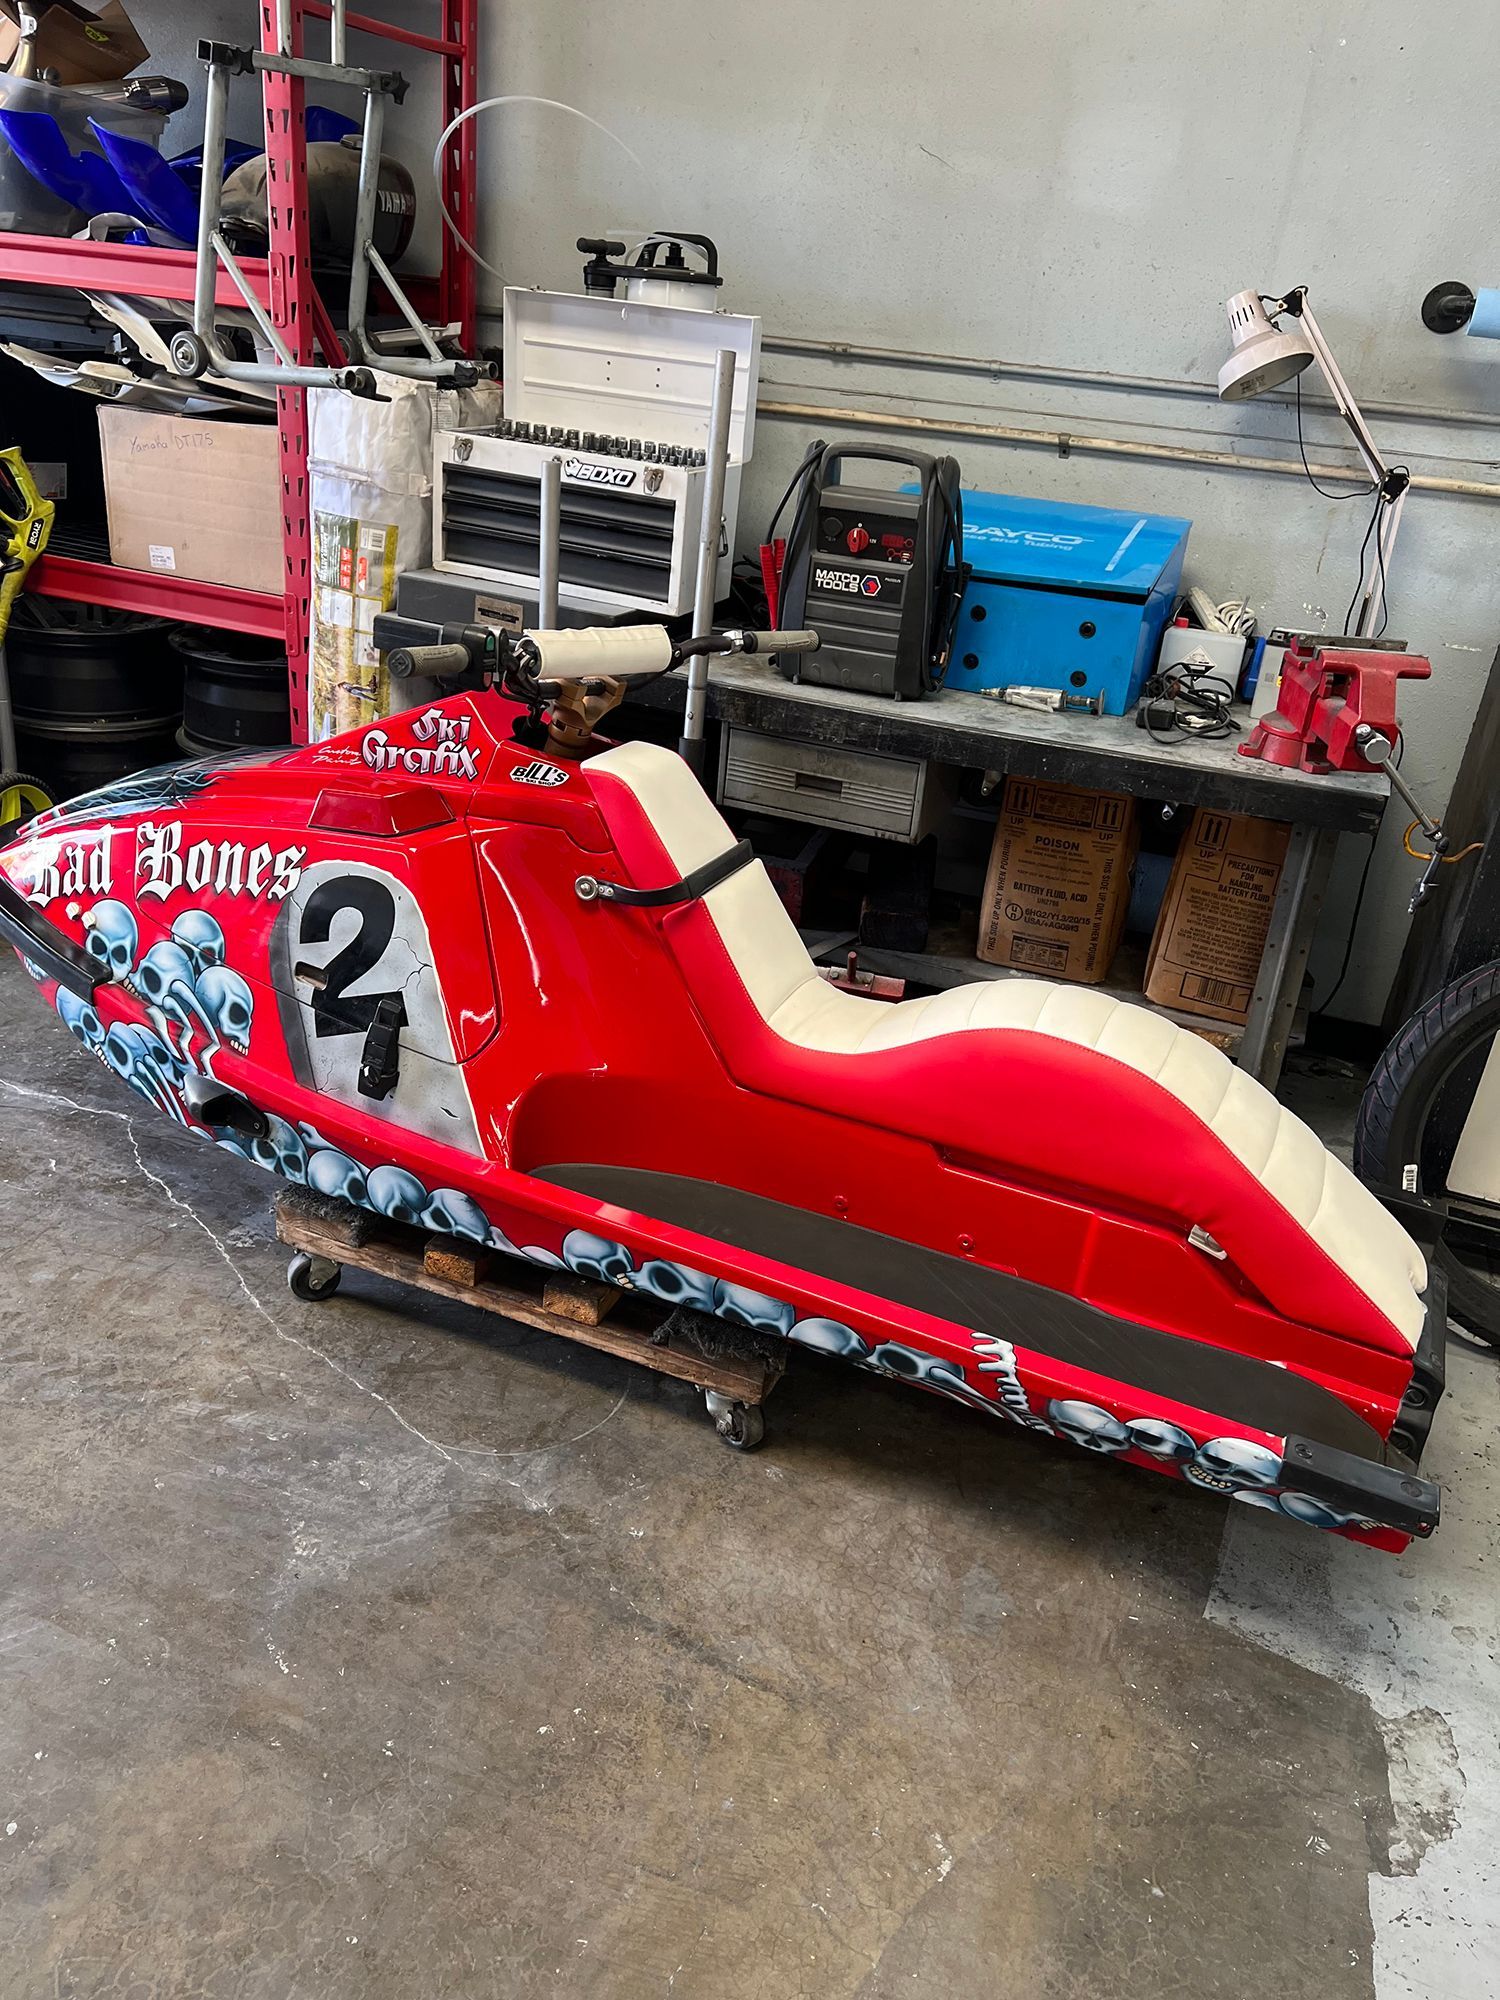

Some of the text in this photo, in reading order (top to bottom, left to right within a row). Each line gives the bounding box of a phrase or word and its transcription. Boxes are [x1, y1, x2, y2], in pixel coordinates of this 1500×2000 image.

[378, 190, 414, 215] YAMAH
[130, 433, 214, 455] Yamaha DT175
[576, 464, 634, 486] BOXO
[29, 522, 42, 545] RYOBI
[963, 523, 1085, 545] DAYCO
[990, 536, 1019, 544] and
[1023, 540, 1073, 551] Tubing
[815, 568, 860, 583] MATCO
[815, 577, 859, 593] TOOLS
[412, 708, 472, 743] Ski
[312, 755, 362, 766] Paint
[362, 729, 481, 781] Grafix
[512, 763, 567, 782] BILL'S
[1010, 816, 1024, 825] UP
[1035, 835, 1080, 851] POISON
[1098, 832, 1114, 841] UP
[1199, 849, 1215, 859] UP
[26, 821, 307, 908] Bad Bones
[1103, 858, 1114, 874] THIS
[1227, 860, 1275, 877] PRECAUTIONS
[1099, 874, 1111, 892] SIDE
[1229, 878, 1264, 893] HANDLING
[1240, 872, 1255, 882] FOR
[987, 839, 1012, 951] THIS SIDE UP ONLY WHEN POURING
[1013, 881, 1088, 903] BATTERY FLUID, ACID
[1098, 892, 1106, 902] UP
[1218, 884, 1270, 903] BATTERY FLUID
[1094, 902, 1105, 920] ONLY
[1090, 922, 1101, 942] WHEN
[300, 875, 409, 1038] 2
[1085, 942, 1098, 971] POURING
